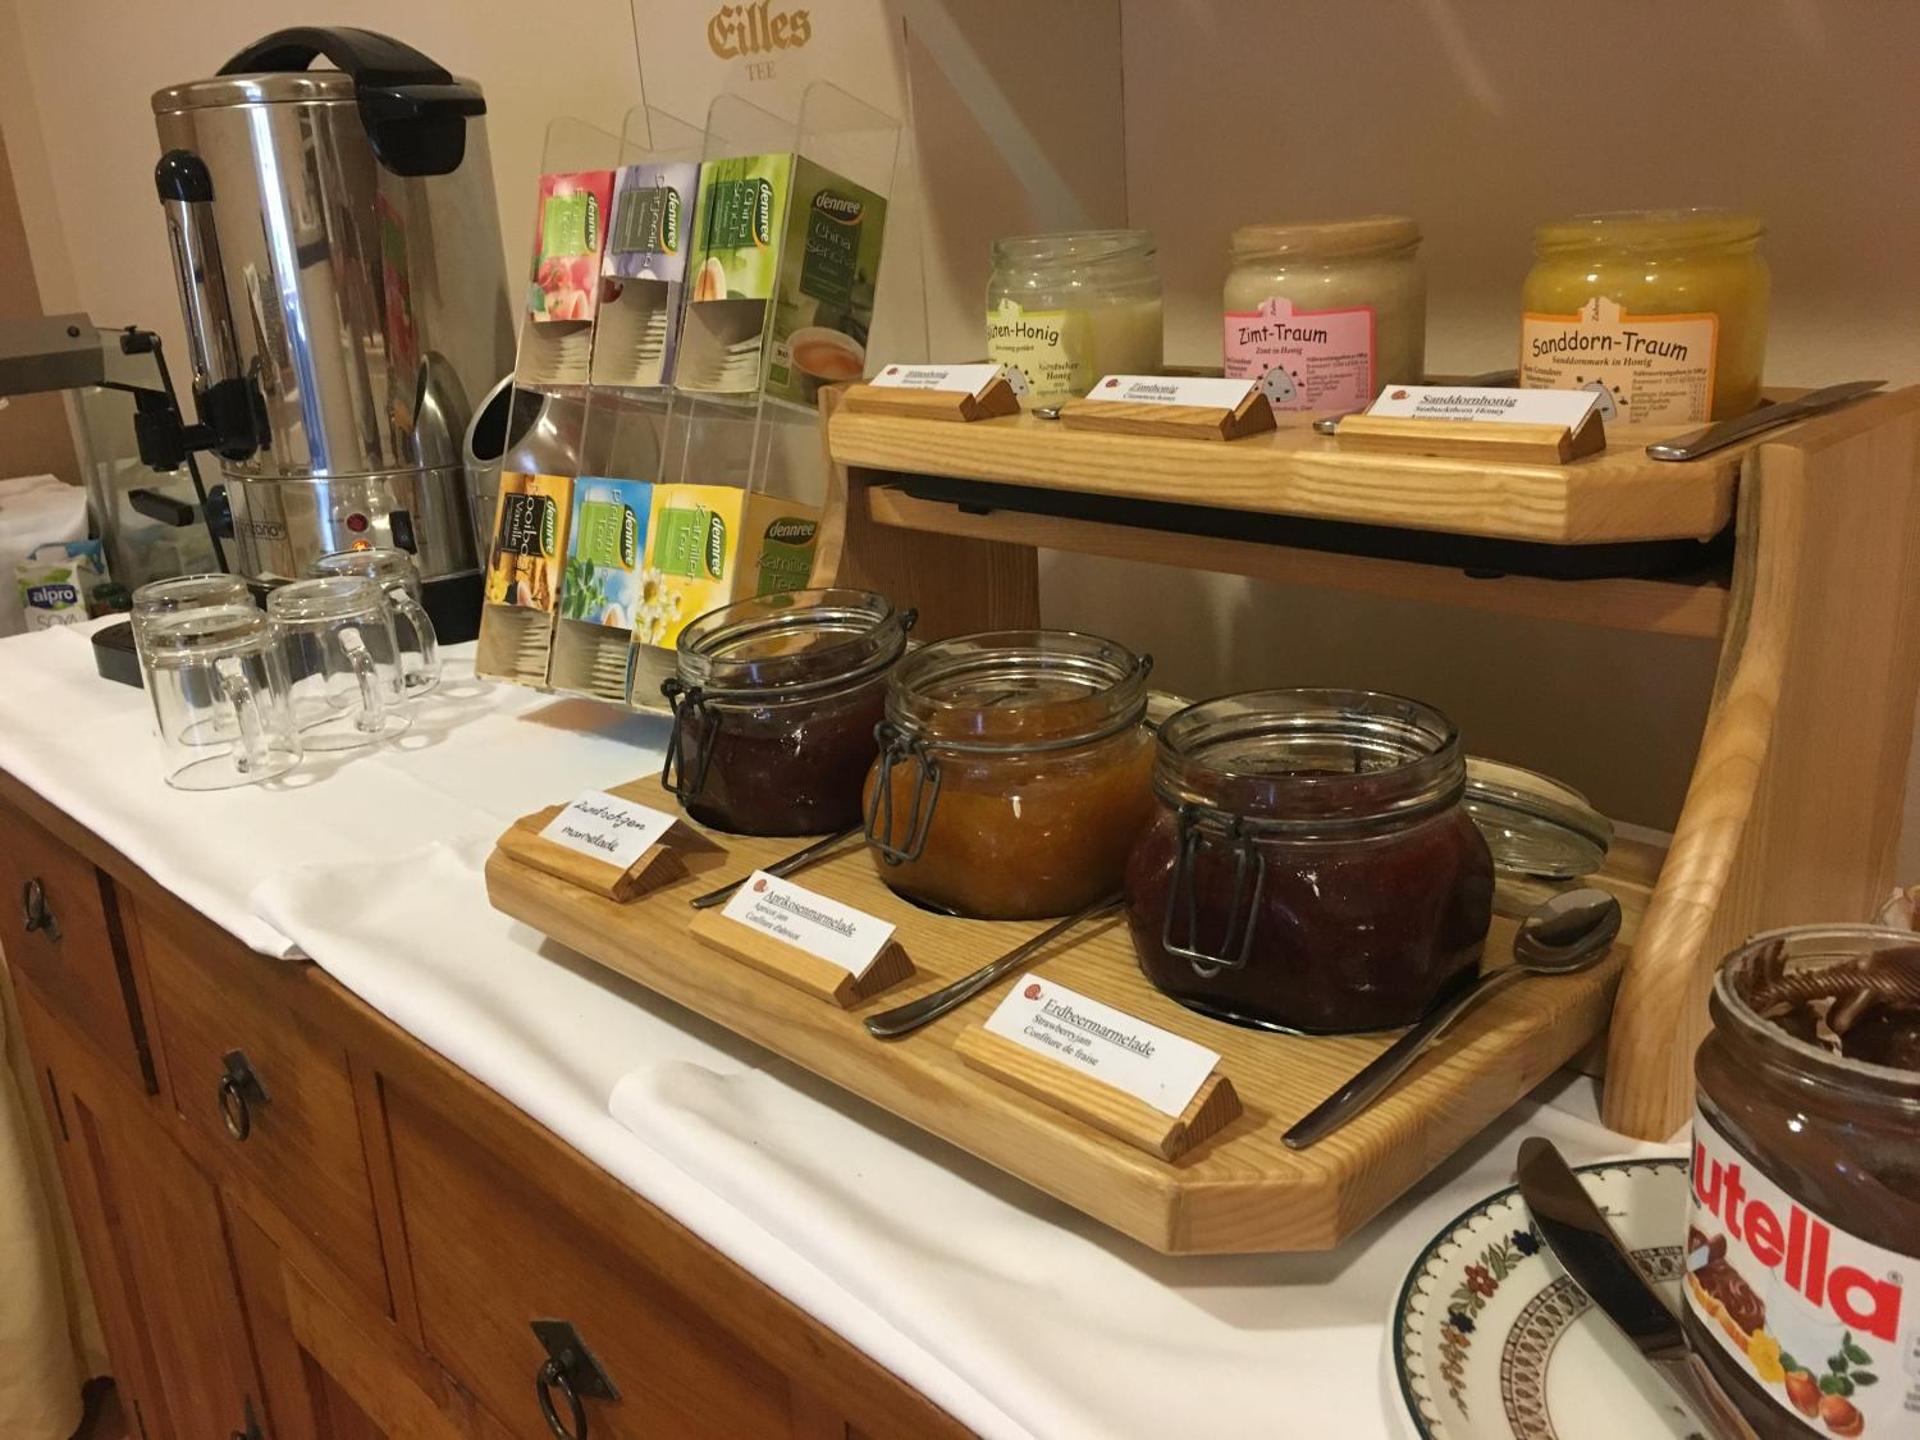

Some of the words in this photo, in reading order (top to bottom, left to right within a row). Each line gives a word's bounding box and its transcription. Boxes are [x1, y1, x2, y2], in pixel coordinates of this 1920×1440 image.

[707, 0, 811, 59] Eilles
[746, 61, 775, 81] TEE
[588, 195, 598, 250] dennree
[643, 175, 665, 267] Darjeeling
[667, 192, 680, 249] dennree
[727, 180, 744, 247] Sencha
[738, 188, 754, 238] China
[759, 183, 773, 242] dennree
[815, 191, 862, 215] dennree
[815, 222, 852, 250] China
[1239, 323, 1328, 345] Zimt-Traum
[1532, 330, 1688, 362] Sanddorn-Traum
[1552, 356, 1609, 366] Sanddornmark
[1612, 358, 1621, 366] in
[1623, 357, 1653, 368] Honig
[1422, 394, 1518, 408] Sanddornhonig
[511, 501, 524, 546] Vanille
[546, 501, 557, 554] dennree
[625, 510, 636, 567] dennree
[677, 526, 693, 561] Tee
[711, 517, 725, 576] dennree
[769, 521, 815, 538] dennree
[33, 587, 74, 605] alpro
[763, 889, 856, 938] Aprikosenmarmelade
[1023, 1026, 1063, 1049] Confiture
[1062, 1044, 1074, 1054] de
[1074, 1048, 1099, 1066] fraise
[1043, 998, 1155, 1057] Erdbeermarmelade
[1690, 1138, 1903, 1343] utella
